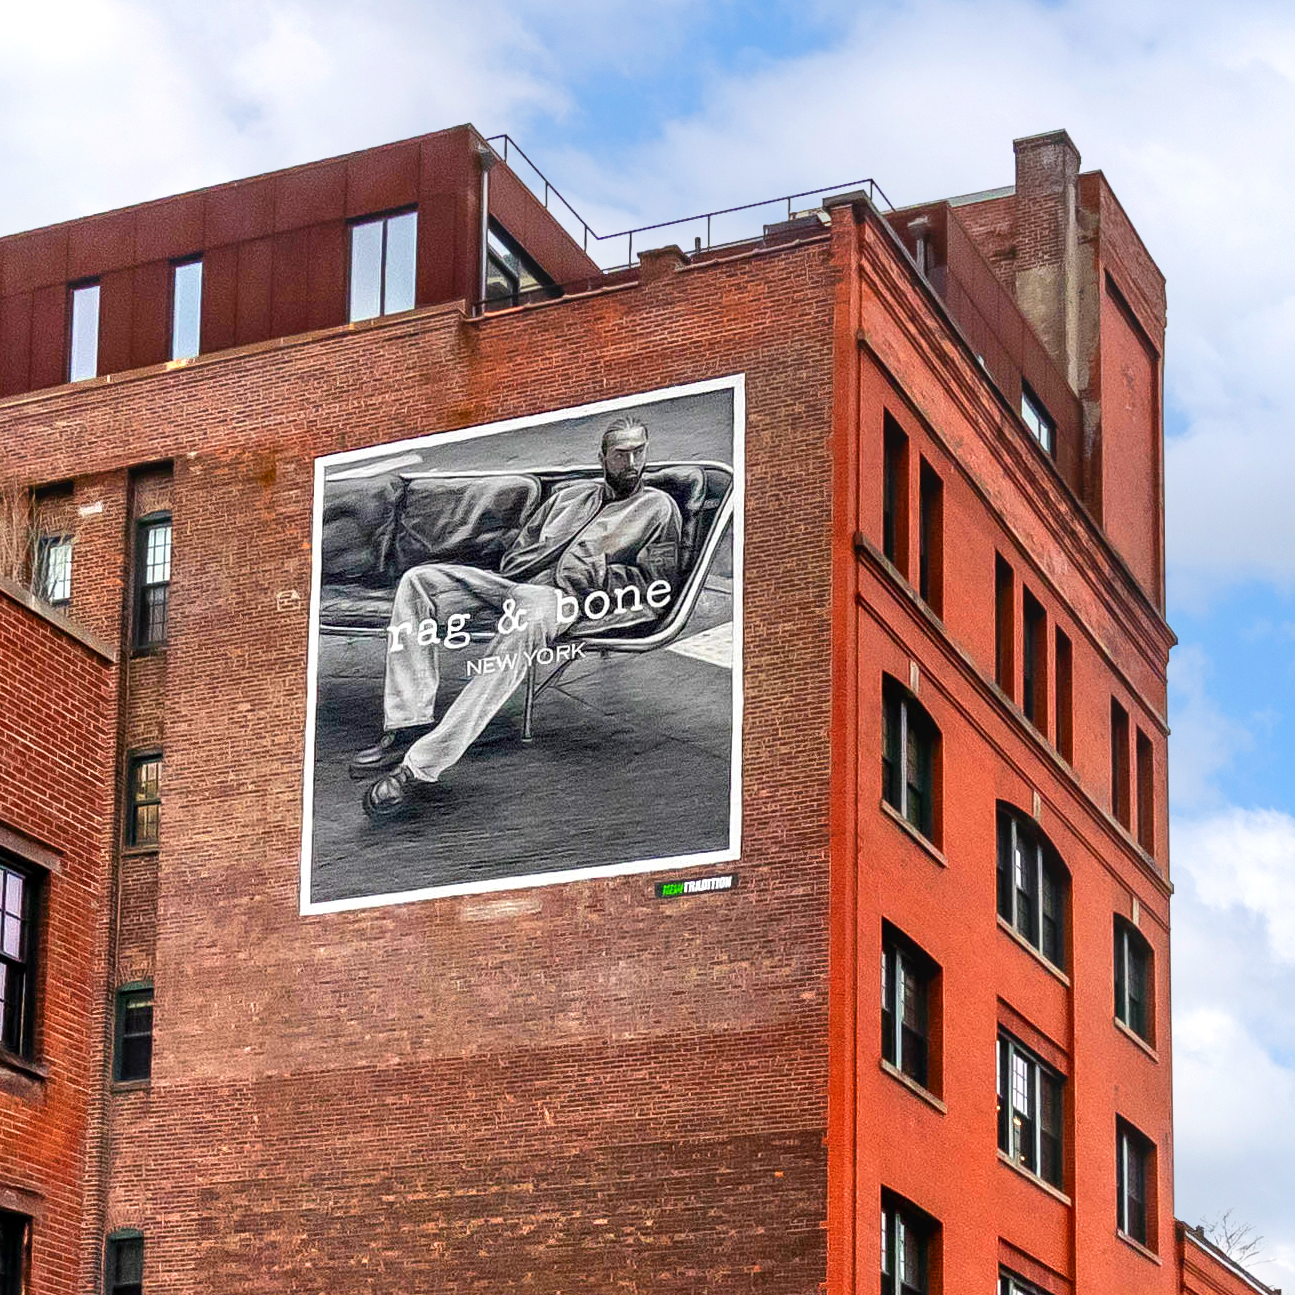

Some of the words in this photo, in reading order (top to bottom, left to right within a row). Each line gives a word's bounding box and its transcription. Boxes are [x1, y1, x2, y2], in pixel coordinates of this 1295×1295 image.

[388, 613, 471, 651] rag
[497, 599, 528, 634] &
[554, 579, 672, 624] bone
[466, 653, 517, 677] NEW
[523, 642, 587, 666] YORK
